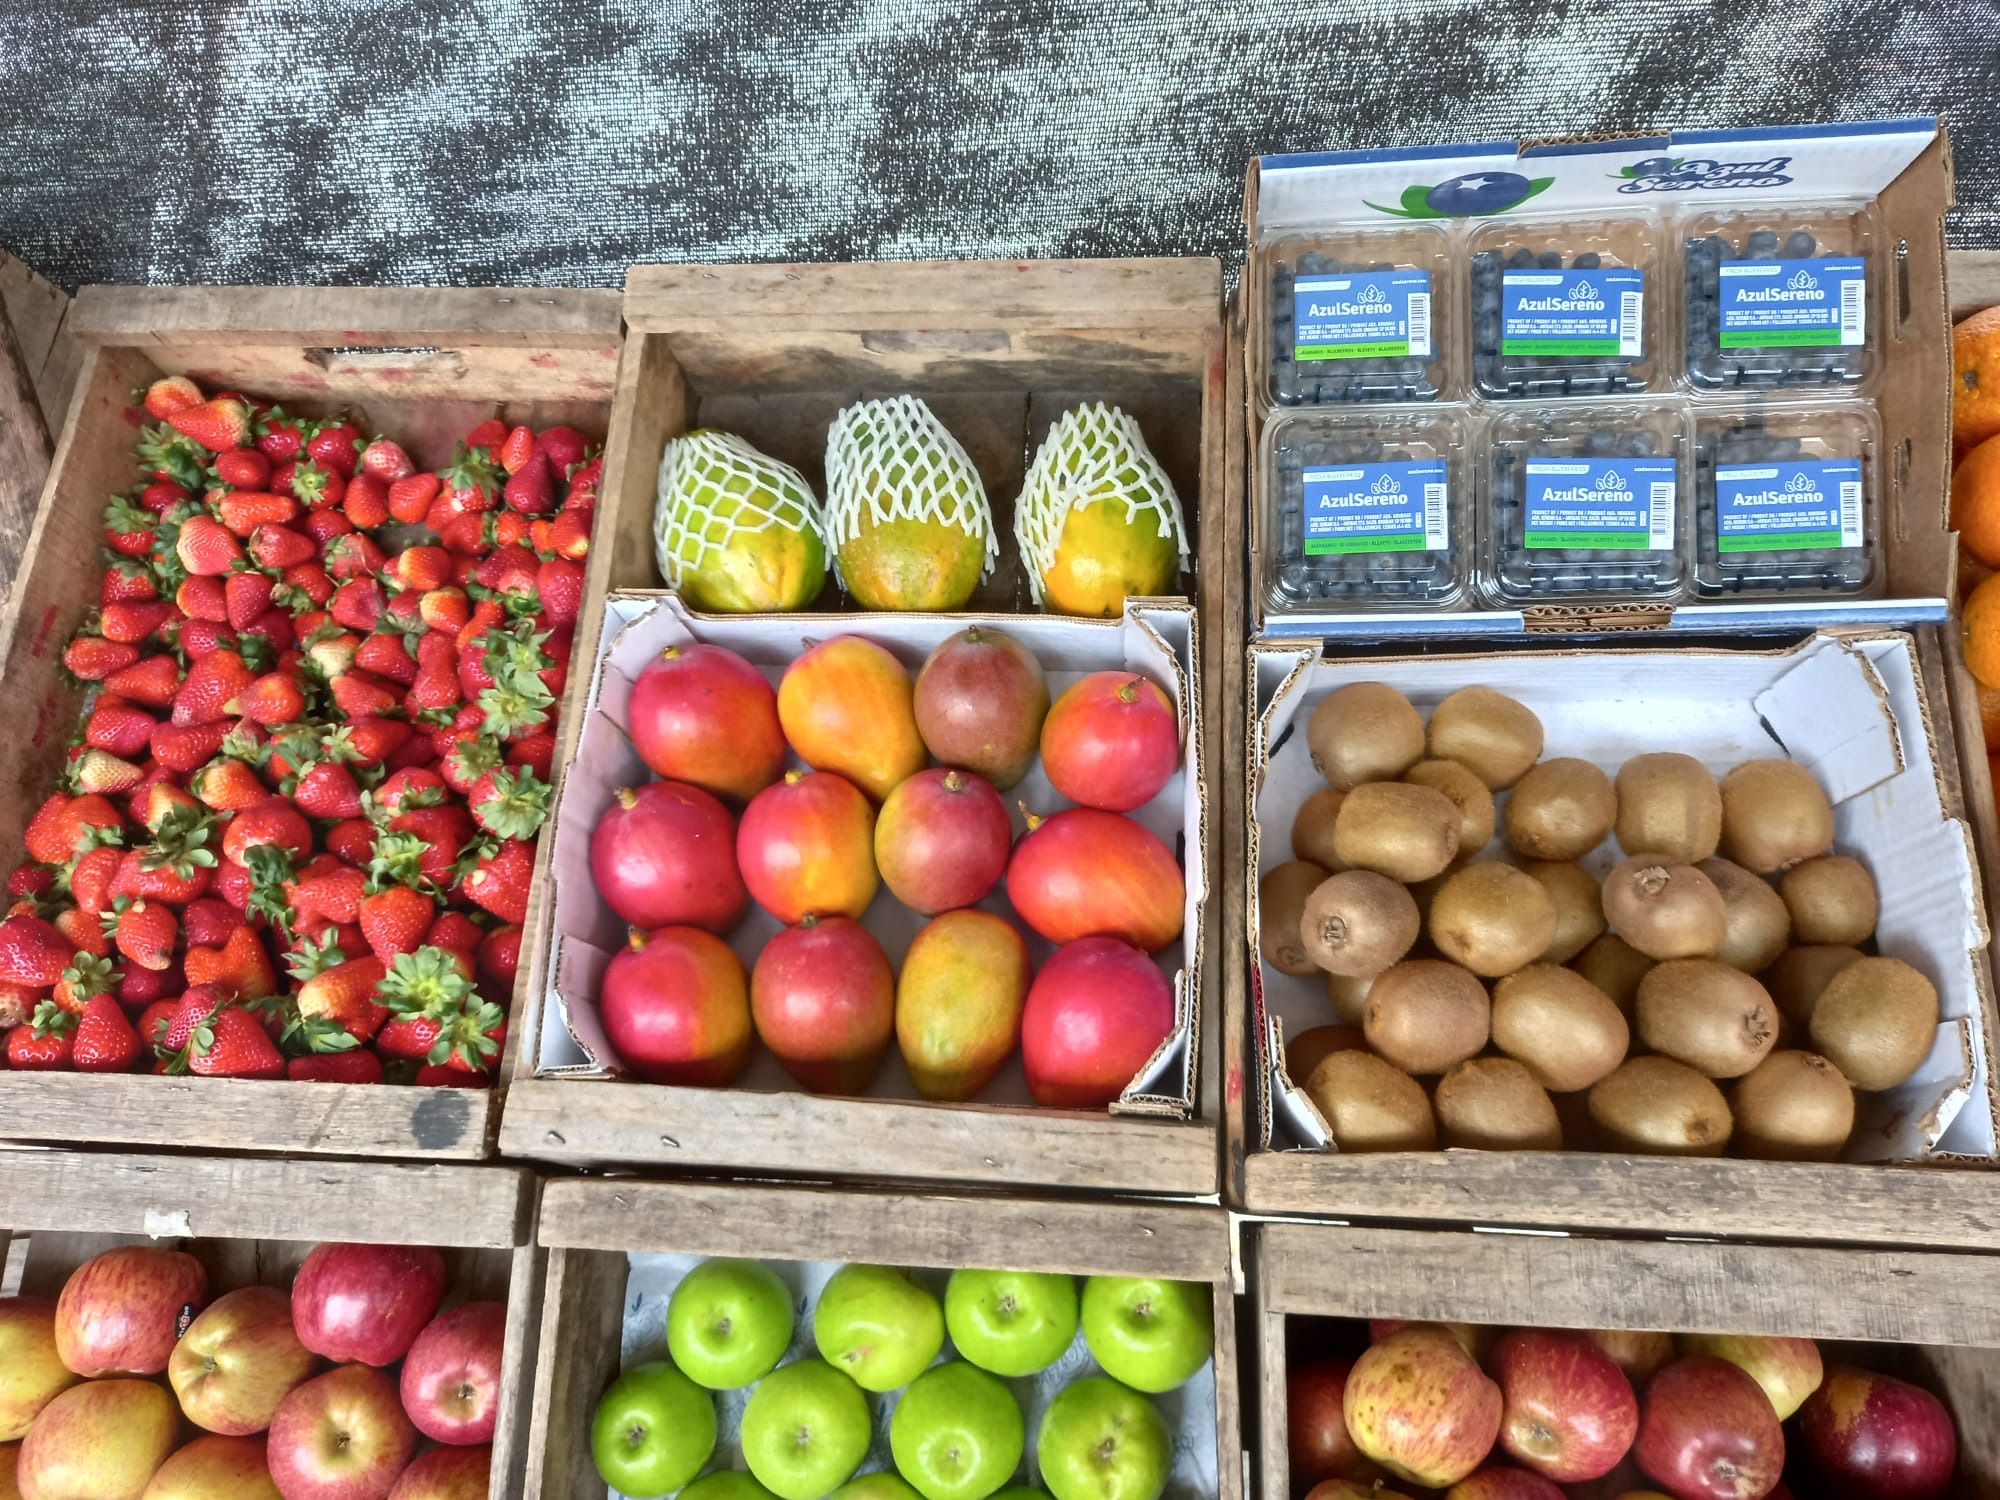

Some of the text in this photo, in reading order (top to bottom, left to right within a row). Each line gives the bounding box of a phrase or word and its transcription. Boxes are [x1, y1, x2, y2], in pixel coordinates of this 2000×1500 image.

[1670, 158, 1789, 179] Azul
[1619, 175, 1788, 193] Sereno
[1736, 288, 1825, 303] AzulSereno
[1308, 302, 1393, 317] AzulSereno
[1517, 297, 1605, 311] AzulSereno
[1320, 493, 1408, 508] AzulSereno
[1542, 487, 1633, 502] AzulSereno
[1733, 491, 1824, 506] AzulSereno
